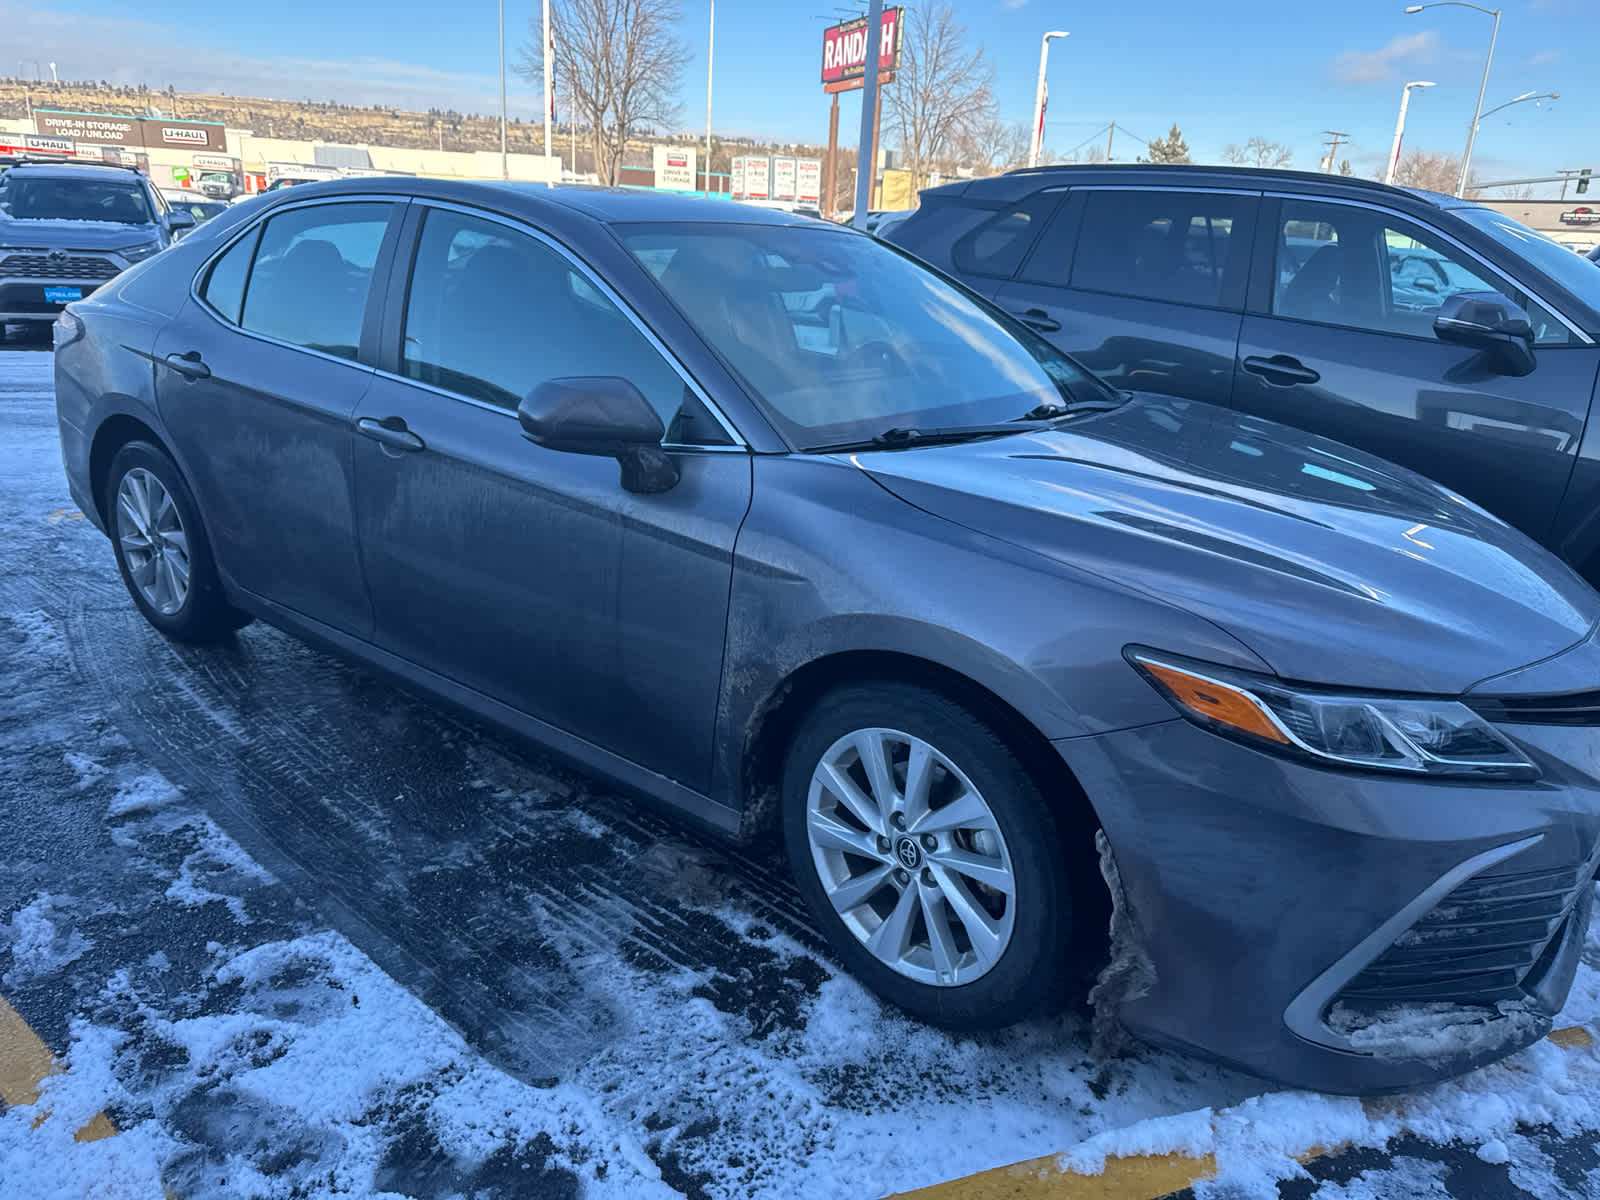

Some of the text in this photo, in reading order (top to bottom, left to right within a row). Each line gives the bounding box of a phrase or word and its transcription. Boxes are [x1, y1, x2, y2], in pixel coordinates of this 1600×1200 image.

[45, 119, 131, 131] DRIVE-IN STORAGE:
[56, 128, 80, 137] LOAD
[86, 130, 123, 139] UNLOAD
[164, 129, 205, 139] U-HAUL
[31, 140, 70, 150] U-HAUL
